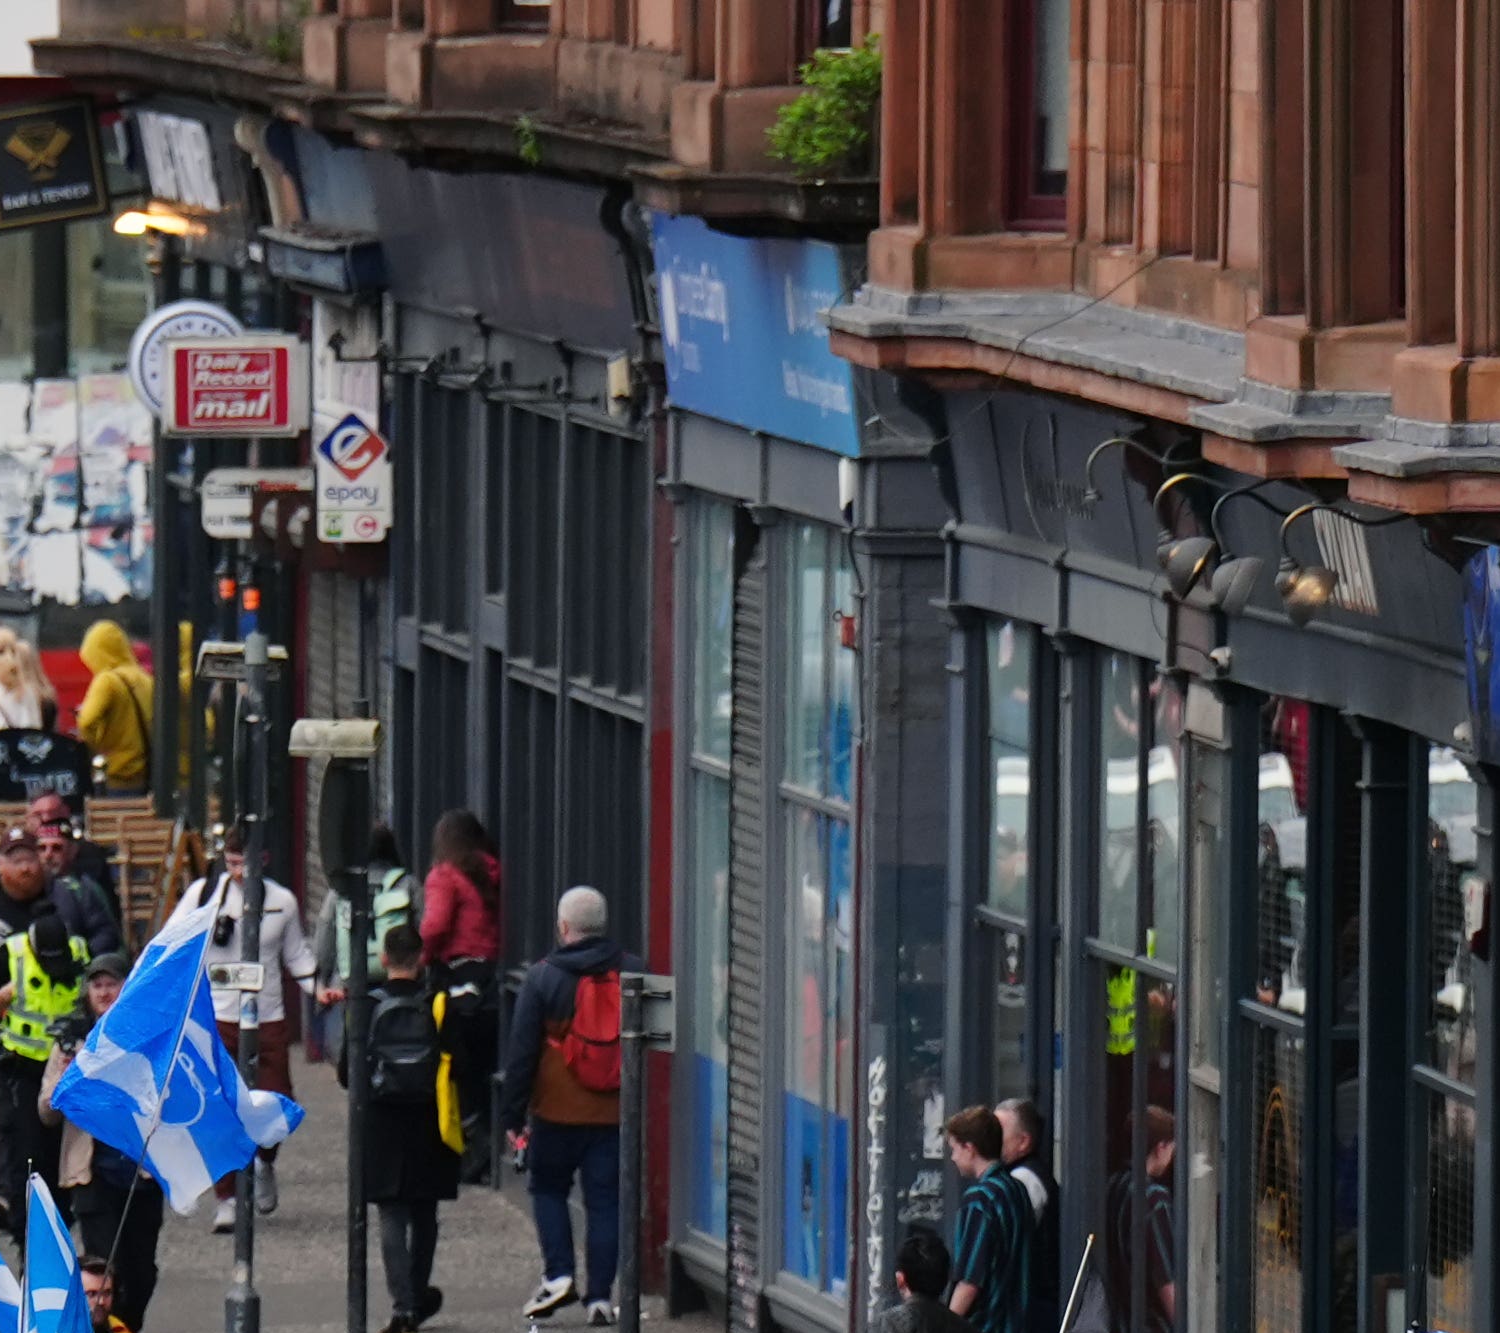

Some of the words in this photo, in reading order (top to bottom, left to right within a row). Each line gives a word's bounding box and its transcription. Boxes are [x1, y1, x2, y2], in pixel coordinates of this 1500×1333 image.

[196, 354, 250, 372] Daily
[195, 371, 269, 387] Record
[194, 393, 268, 419] mail
[324, 486, 379, 507] epay
